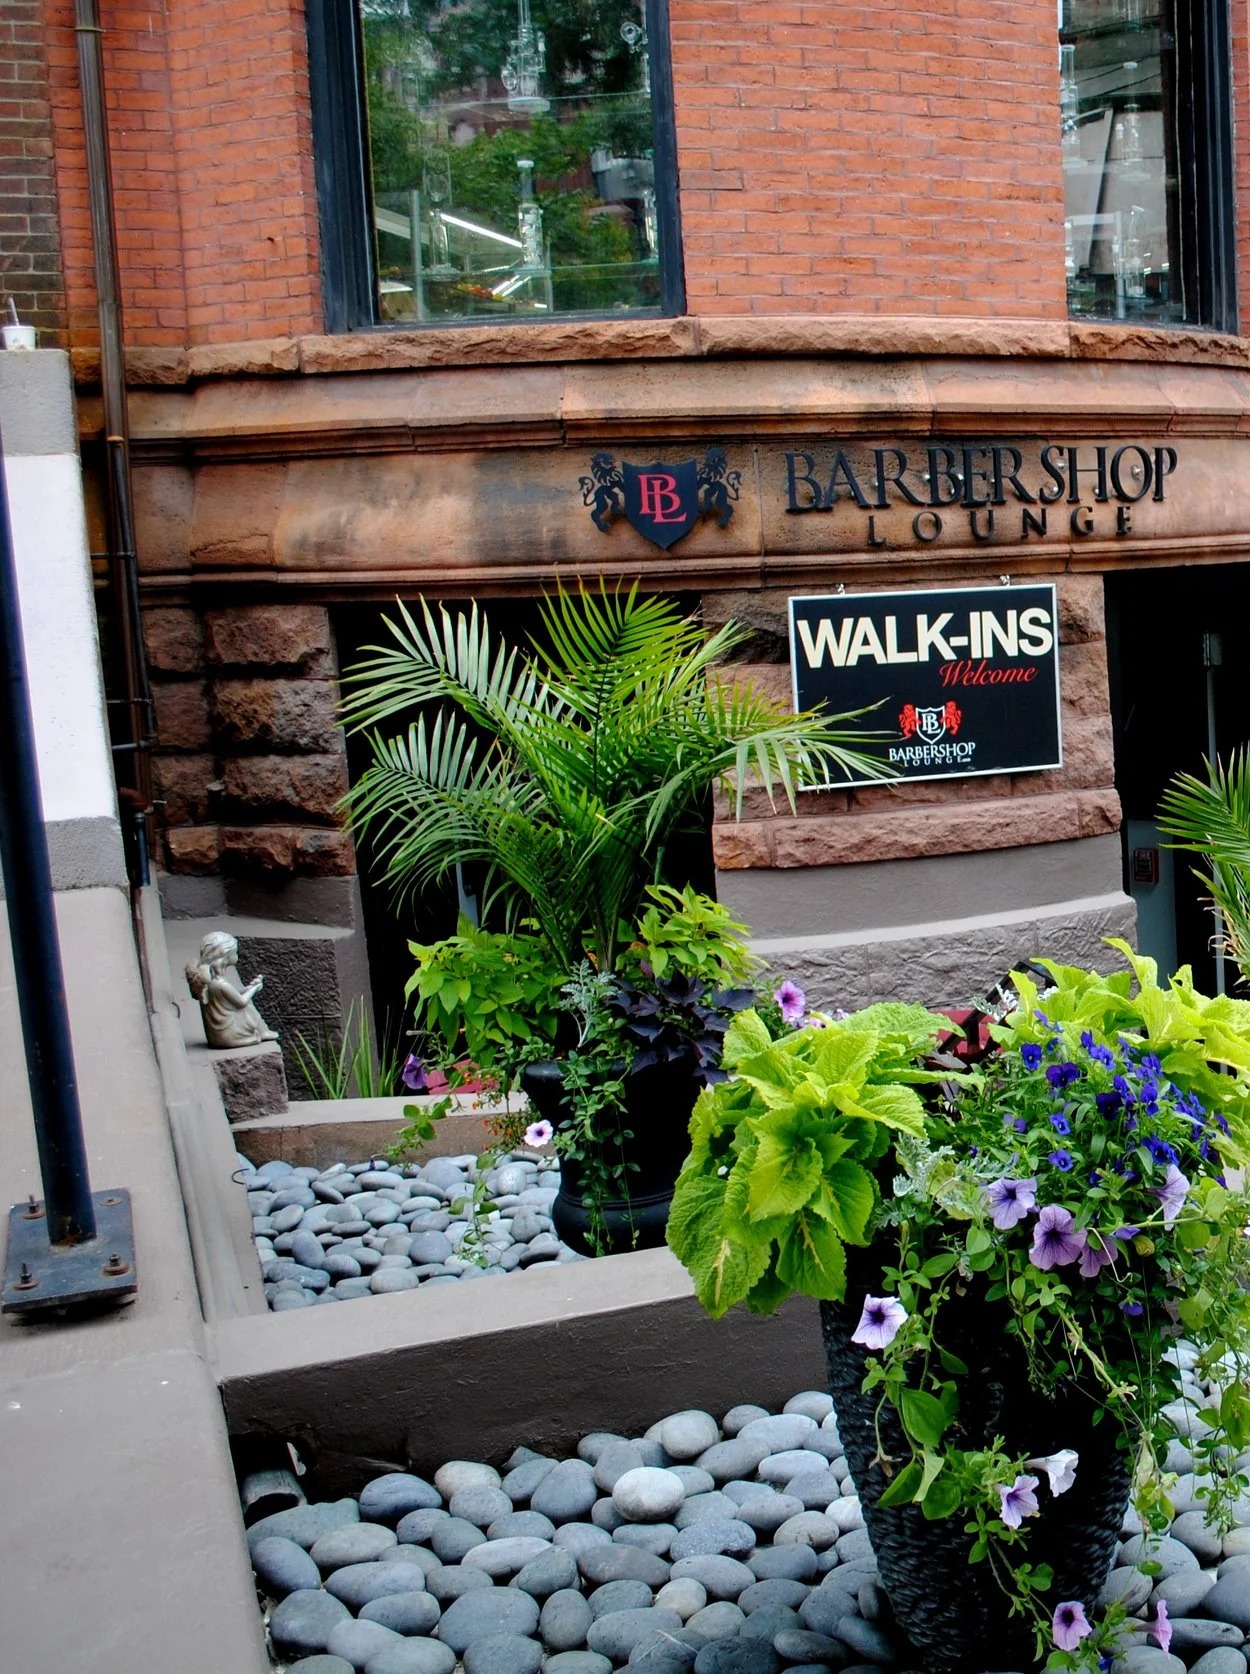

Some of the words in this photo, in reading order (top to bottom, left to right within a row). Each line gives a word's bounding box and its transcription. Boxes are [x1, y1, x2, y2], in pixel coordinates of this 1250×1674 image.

[785, 445, 1178, 513] BARBERSHOP
[867, 505, 1133, 546] LOUNGE
[796, 607, 1053, 669] WALK-INS
[939, 659, 1038, 688] Welcome
[889, 741, 976, 761] BARBERSHOP
